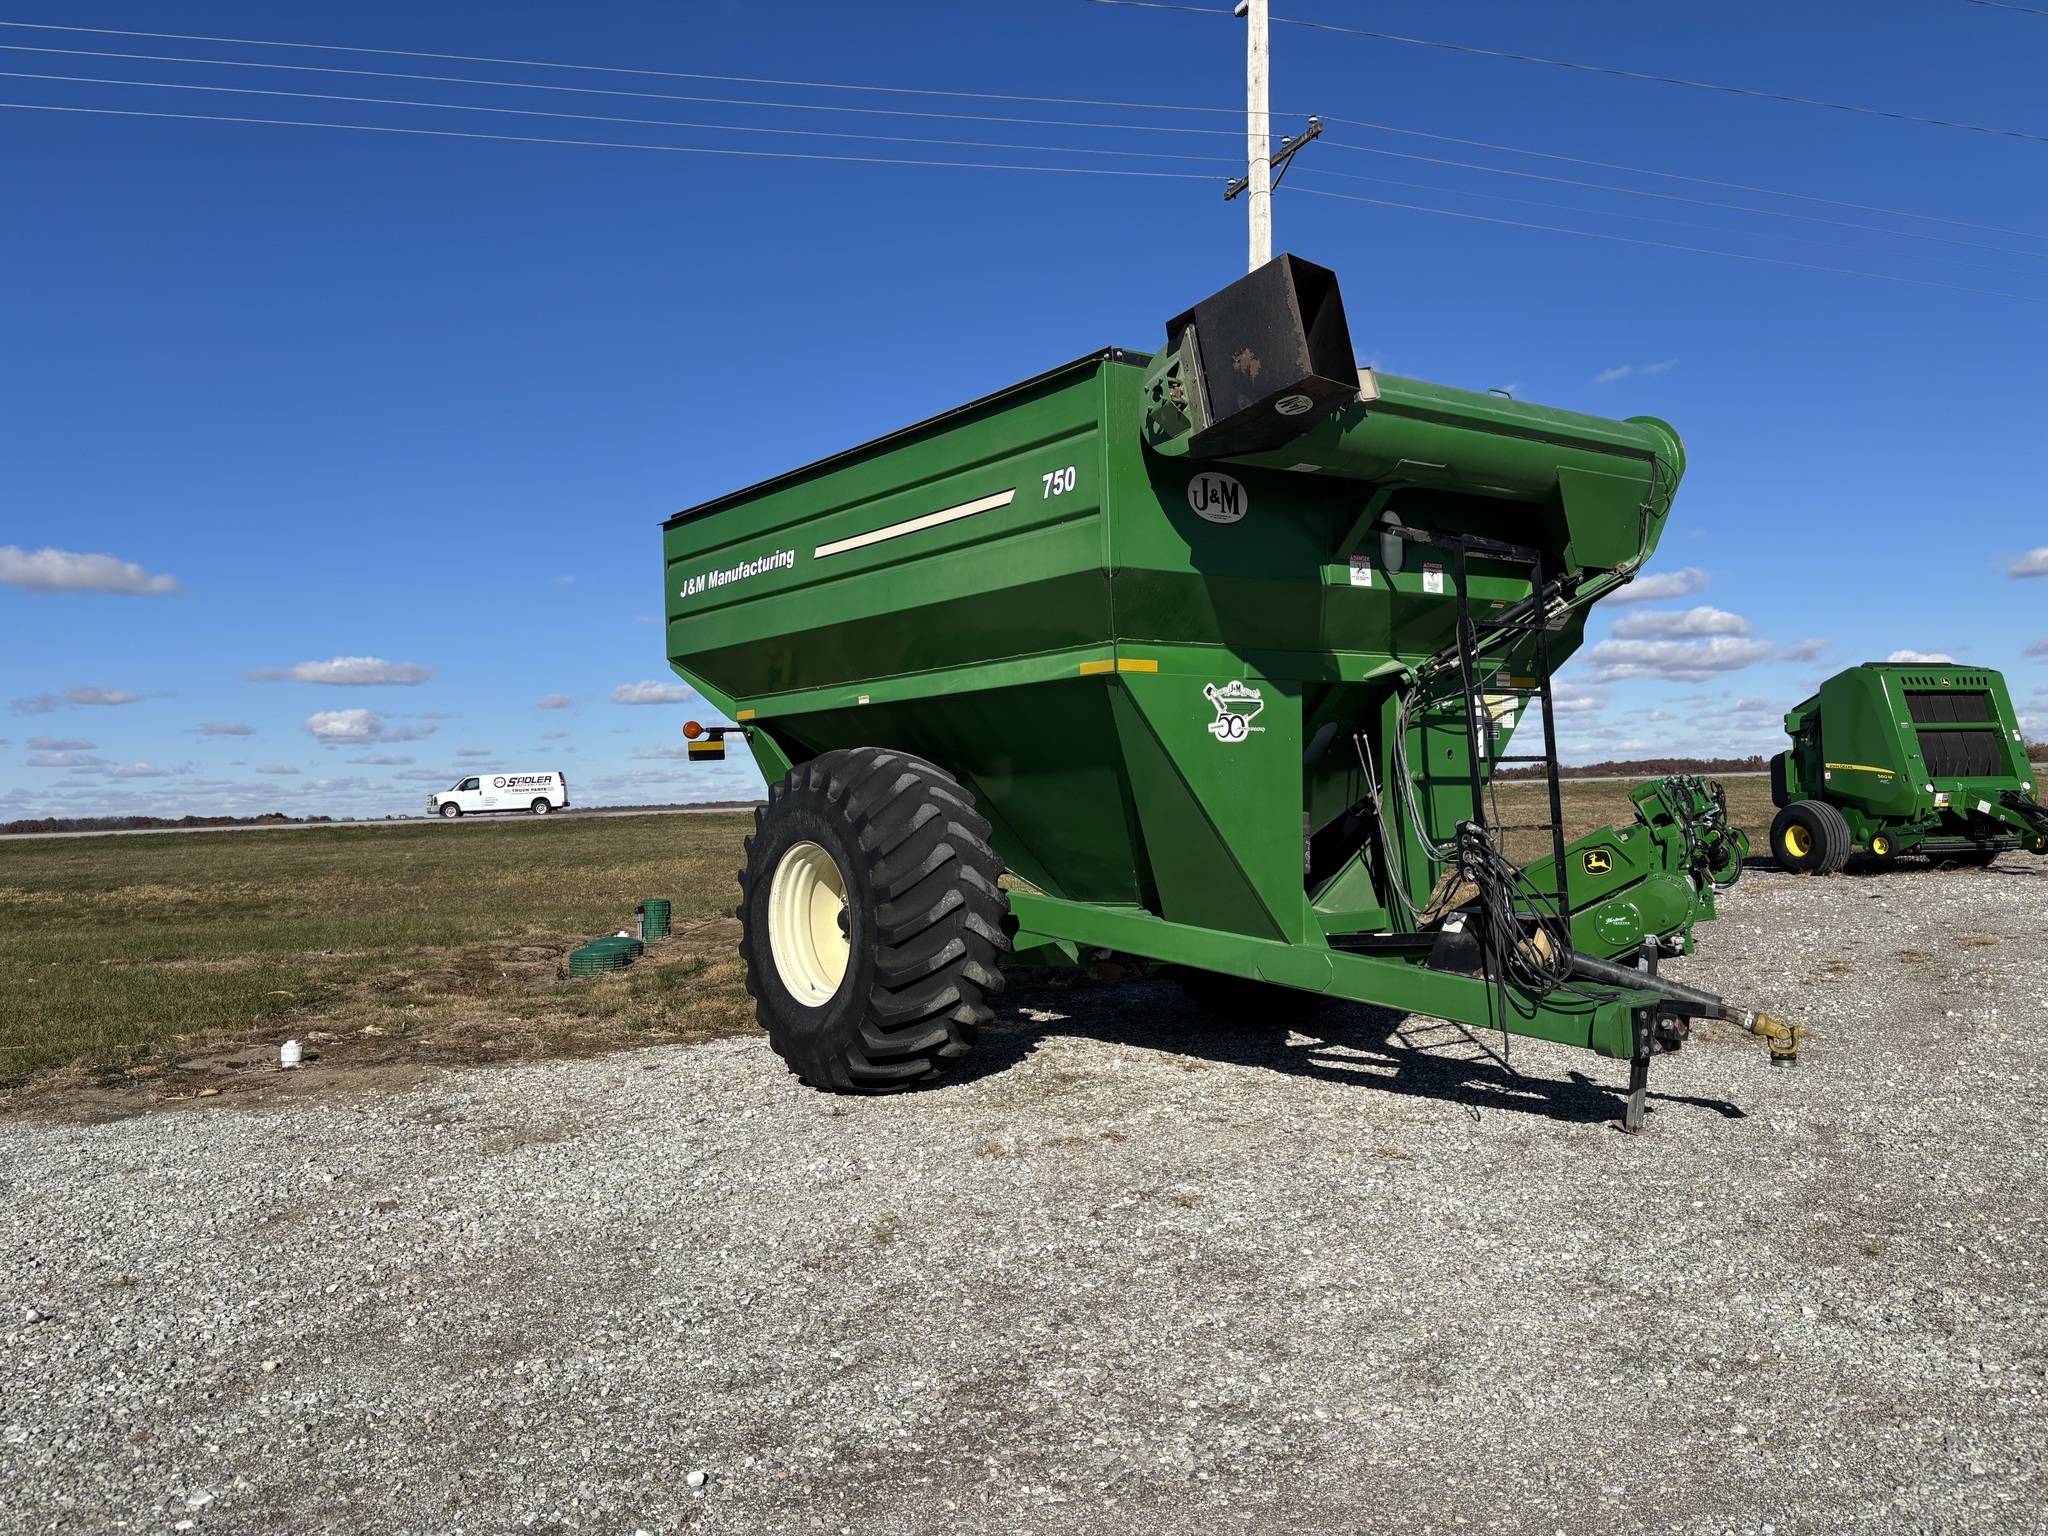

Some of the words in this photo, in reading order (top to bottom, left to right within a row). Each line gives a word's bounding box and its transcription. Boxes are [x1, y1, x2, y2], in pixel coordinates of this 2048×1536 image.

[1042, 465, 1076, 500] 750
[1192, 477, 1241, 515] J&M
[680, 574, 706, 598] J&M
[708, 549, 795, 589] Manufacturing
[506, 776, 552, 787] SADLER
